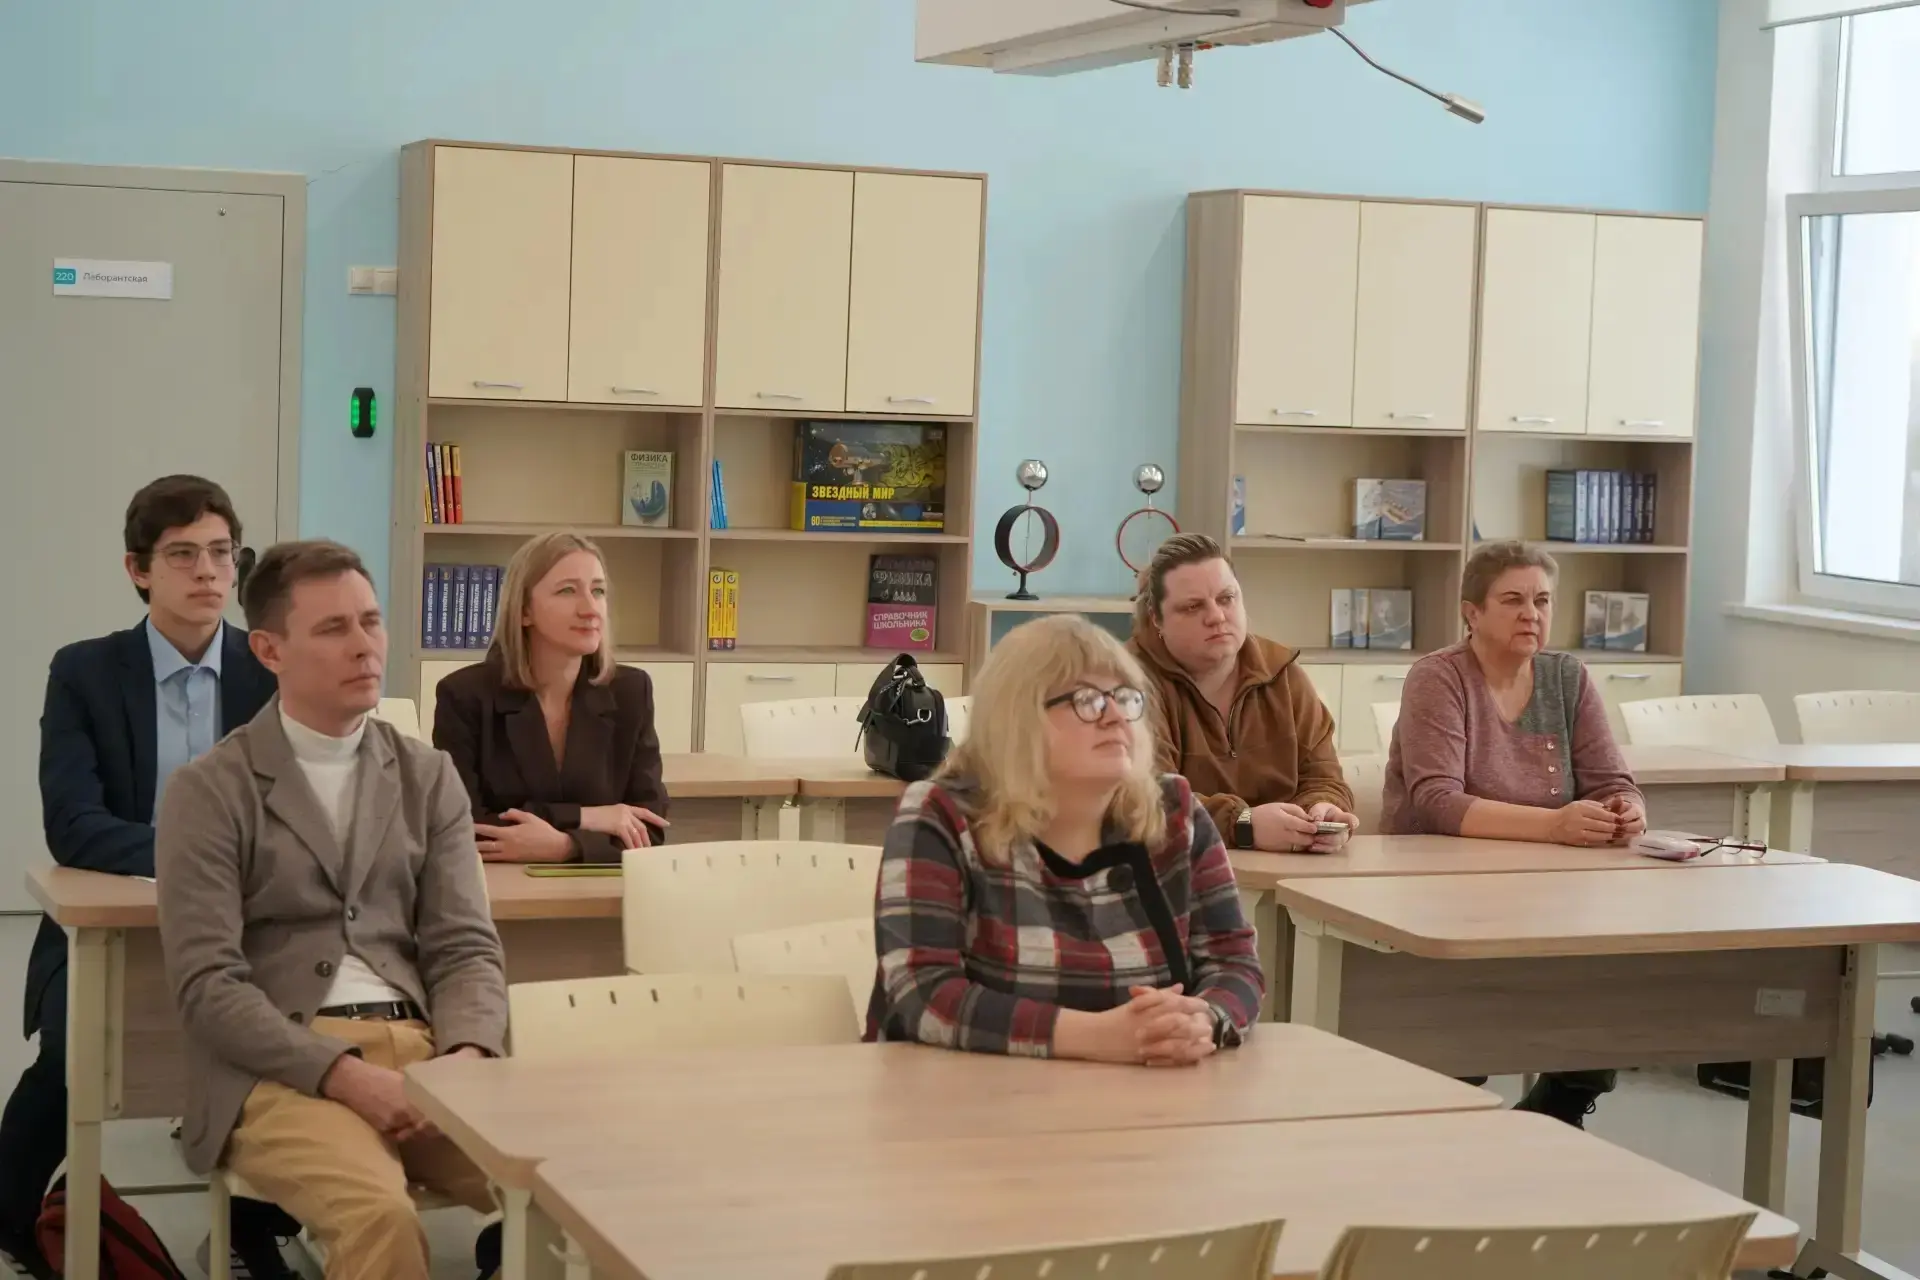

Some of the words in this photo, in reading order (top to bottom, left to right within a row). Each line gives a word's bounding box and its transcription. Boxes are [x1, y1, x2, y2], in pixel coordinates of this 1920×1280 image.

[55, 272, 74, 281] 220
[83, 272, 148, 283] Лаборантская
[631, 453, 668, 463] ФИЗИКА
[812, 484, 869, 501] ЗВЕЗДНЫЙ
[872, 487, 895, 500] МИР
[872, 570, 933, 587] ФИЗИКА
[873, 610, 928, 622] СПРАВОЧНИК
[873, 619, 926, 630] ШКОЛЬНИКА
